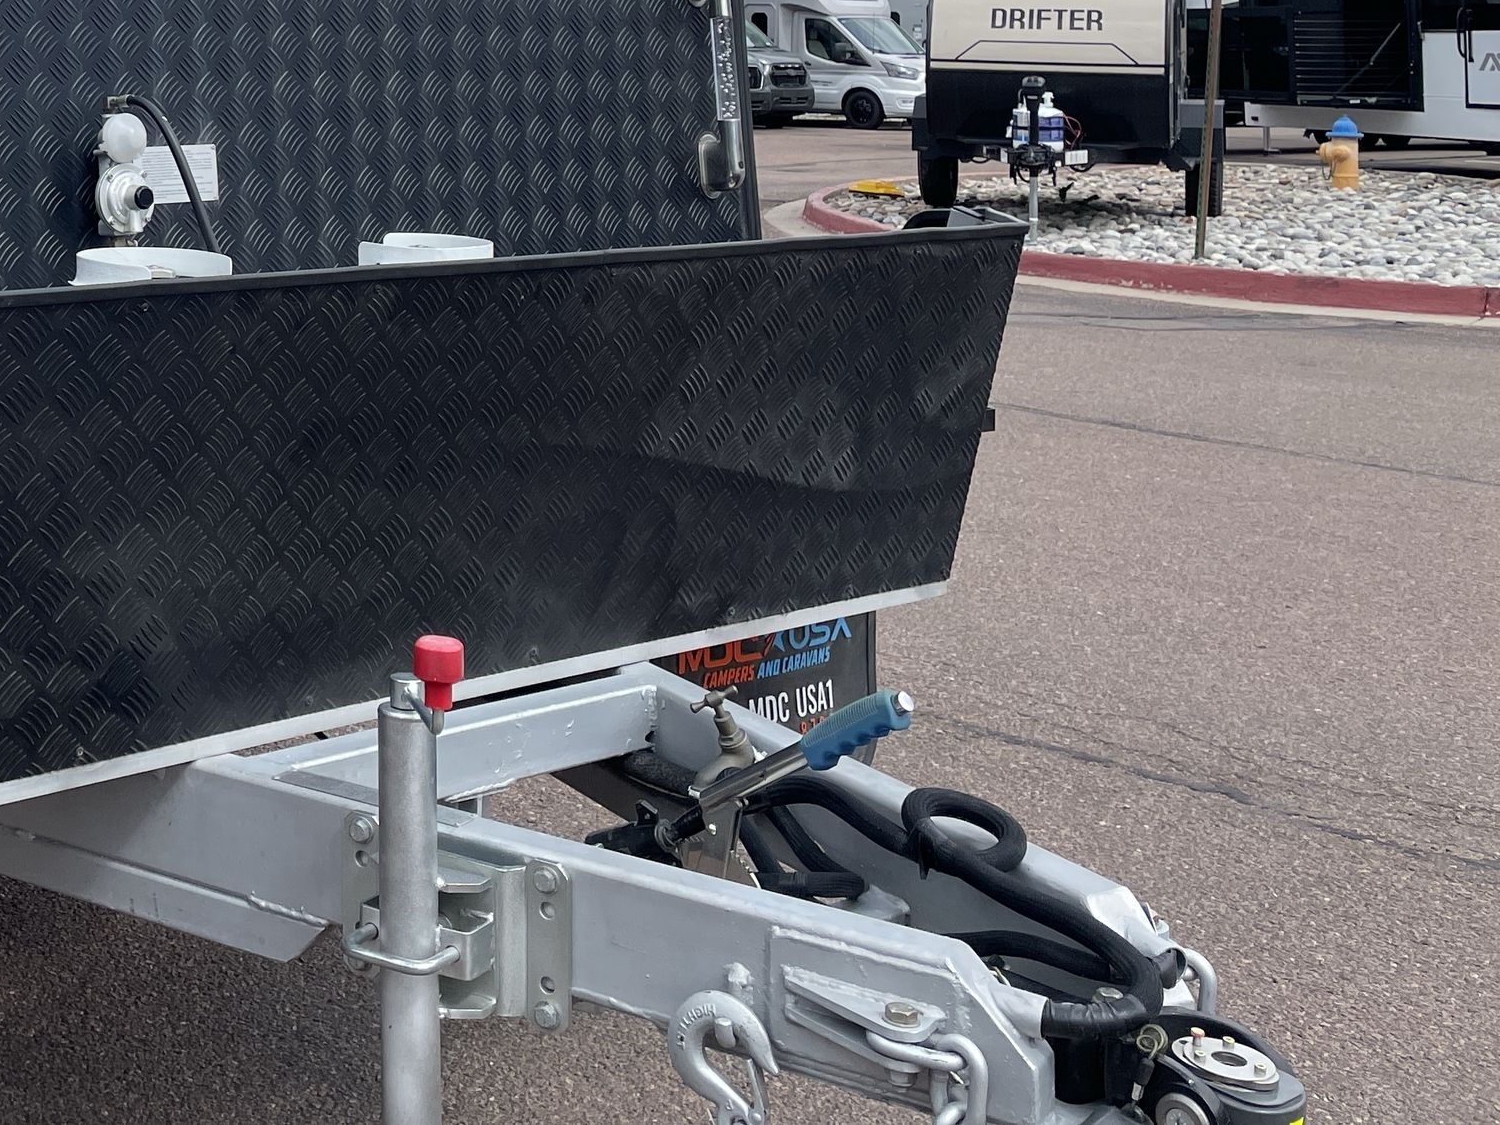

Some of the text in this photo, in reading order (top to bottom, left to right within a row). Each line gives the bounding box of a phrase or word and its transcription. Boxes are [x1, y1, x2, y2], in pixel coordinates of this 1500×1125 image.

[991, 8, 1104, 31] DRIFTER
[703, 646, 831, 689] CAMPERS AND CARAVANS
[796, 679, 834, 718] USA1
